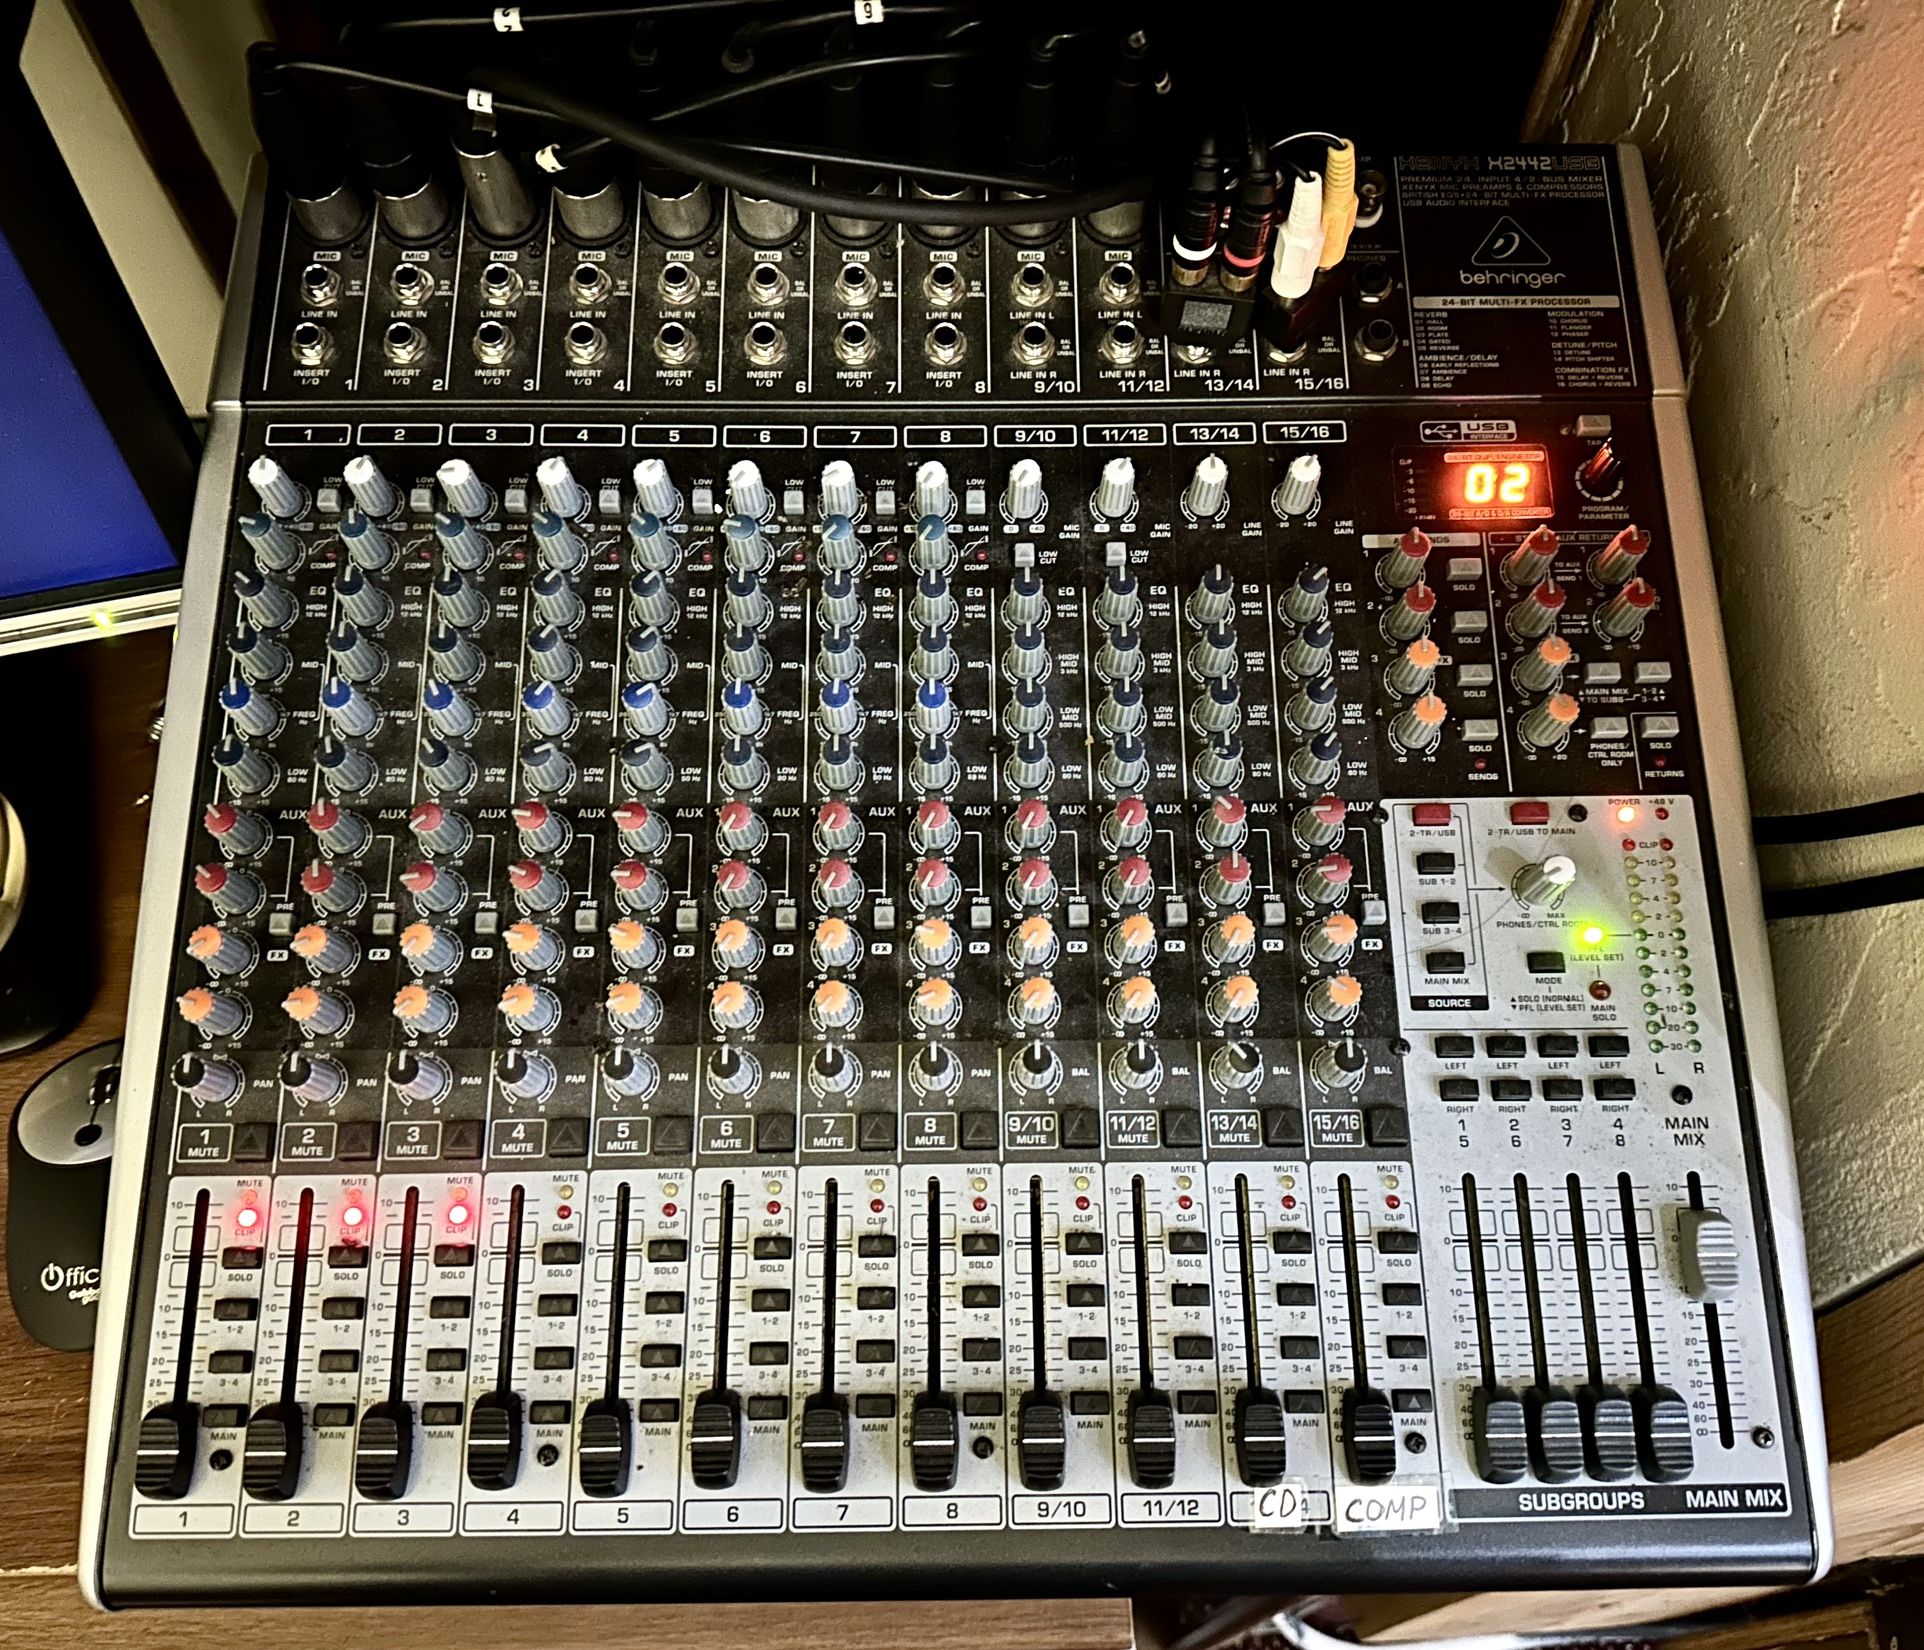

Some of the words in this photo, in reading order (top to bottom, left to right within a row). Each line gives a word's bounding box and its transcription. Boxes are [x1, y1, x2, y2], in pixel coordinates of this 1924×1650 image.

[1488, 156, 1601, 170] X2442USB
[1459, 270, 1566, 288] behringer
[1442, 298, 1477, 306] 24-BIT
[1479, 298, 1528, 306] MULTI-FX
[1531, 298, 1591, 306] PROCESSOR
[345, 379, 352, 390] 1
[432, 379, 443, 391] 2
[523, 379, 534, 391] 3
[613, 380, 625, 391] 4
[706, 380, 716, 392] 5
[796, 381, 806, 393] 6
[886, 381, 896, 393] 7
[975, 381, 985, 393] 8
[1034, 381, 1075, 393] 9/10
[1118, 380, 1164, 392] 11/12
[1205, 379, 1254, 391] 13/14
[1295, 377, 1344, 390] 15/16
[1280, 426, 1329, 438] 15/16
[1466, 423, 1509, 431] USB
[304, 429, 312, 440] 1
[394, 429, 405, 440] 2
[486, 429, 497, 441] 3
[577, 429, 588, 441] 4
[669, 430, 680, 442] 5
[760, 431, 770, 443] 6
[850, 431, 861, 443] 7
[940, 431, 951, 442] 8
[1015, 430, 1056, 442] 9/10
[1102, 429, 1148, 441] 11/12
[1190, 427, 1240, 440] 13/14
[1464, 463, 1530, 503] 02
[1581, 505, 1629, 513] PROGRAM/
[1612, 751, 1634, 759] ROOM
[1601, 759, 1623, 767] ONLY
[1645, 770, 1684, 778] RETURNS
[378, 809, 407, 819] AUX
[478, 809, 507, 818] AUX
[578, 808, 605, 818] AUX
[676, 808, 703, 818] AUX
[773, 807, 800, 817] AUX
[869, 807, 895, 816] AUX
[964, 806, 991, 816] AUX
[1059, 805, 1086, 815] AUX
[1155, 804, 1182, 814] AUX
[1251, 803, 1277, 813] AUX
[1345, 802, 1374, 814] AUX
[280, 810, 307, 819] AUX
[1409, 829, 1456, 837] 2-TR/USB
[1488, 828, 1535, 836] 2-TR/USB
[1639, 841, 1658, 849] CLIP
[1422, 927, 1441, 935] SUB
[1444, 927, 1462, 935] 3-4
[1428, 999, 1471, 1007] SOURCE
[1542, 994, 1584, 1002] (NORMAL)
[1519, 1004, 1534, 1012] PFL
[1536, 1004, 1565, 1012] (LEVEL
[1445, 1062, 1466, 1070] LEFT
[1496, 1062, 1518, 1070] LEFT
[1548, 1062, 1569, 1070] LEFT
[1599, 1061, 1621, 1069] LEFT
[1655, 1062, 1665, 1075] L
[1693, 1062, 1705, 1074] R
[1446, 1106, 1474, 1114] RIGHT
[1498, 1105, 1526, 1113] RIGHT
[1550, 1105, 1578, 1113] RIGHT
[721, 1121, 733, 1136] 6
[823, 1119, 835, 1134] 7
[924, 1118, 936, 1133] 8
[1009, 1116, 1054, 1132] 9/10
[1110, 1115, 1155, 1131] 11/12
[1211, 1115, 1257, 1131] 13/14
[1313, 1115, 1359, 1130] 15/16
[1458, 1119, 1465, 1131] 1
[1509, 1119, 1519, 1131] 2
[1561, 1118, 1571, 1131] 3
[1613, 1118, 1623, 1130] 4
[1665, 1117, 1709, 1129] MAIN
[302, 1128, 315, 1143] 2
[407, 1126, 420, 1142] 3
[512, 1123, 525, 1140] 4
[617, 1122, 629, 1138] 5
[200, 1129, 210, 1144] 1
[813, 1137, 844, 1146] MUTE
[915, 1136, 946, 1145] MUTE
[1016, 1135, 1047, 1144] MUTE
[1118, 1134, 1148, 1143] MUTE
[1219, 1133, 1250, 1142] MUTE
[1322, 1133, 1353, 1142] MUTE
[1459, 1135, 1469, 1148] 5
[1511, 1135, 1521, 1147] 6
[1563, 1135, 1572, 1147] 7
[1615, 1134, 1625, 1147] 8
[1674, 1133, 1705, 1146] MIX
[501, 1143, 533, 1153] MUTE
[607, 1141, 638, 1150] MUTE
[711, 1138, 742, 1148] MUTE
[188, 1147, 219, 1157] MUTE
[291, 1146, 323, 1156] MUTE
[396, 1145, 428, 1154] MUTE
[40, 1262, 100, 1291] Offic
[1258, 1488, 1297, 1517] CD
[1519, 1492, 1644, 1511] SUBGROUPS
[1686, 1490, 1739, 1508] MAIN
[1745, 1489, 1783, 1507] MIX
[837, 1504, 849, 1521] 7
[947, 1503, 958, 1519] 8
[1038, 1501, 1086, 1518] 9/10
[1143, 1499, 1199, 1516] 11/12
[1344, 1496, 1427, 1524] COMP
[179, 1511, 187, 1527] 1
[287, 1510, 300, 1527] 2
[397, 1509, 409, 1526] 3
[507, 1509, 519, 1524] 4
[617, 1507, 629, 1524] 5
[727, 1506, 739, 1522] 6
